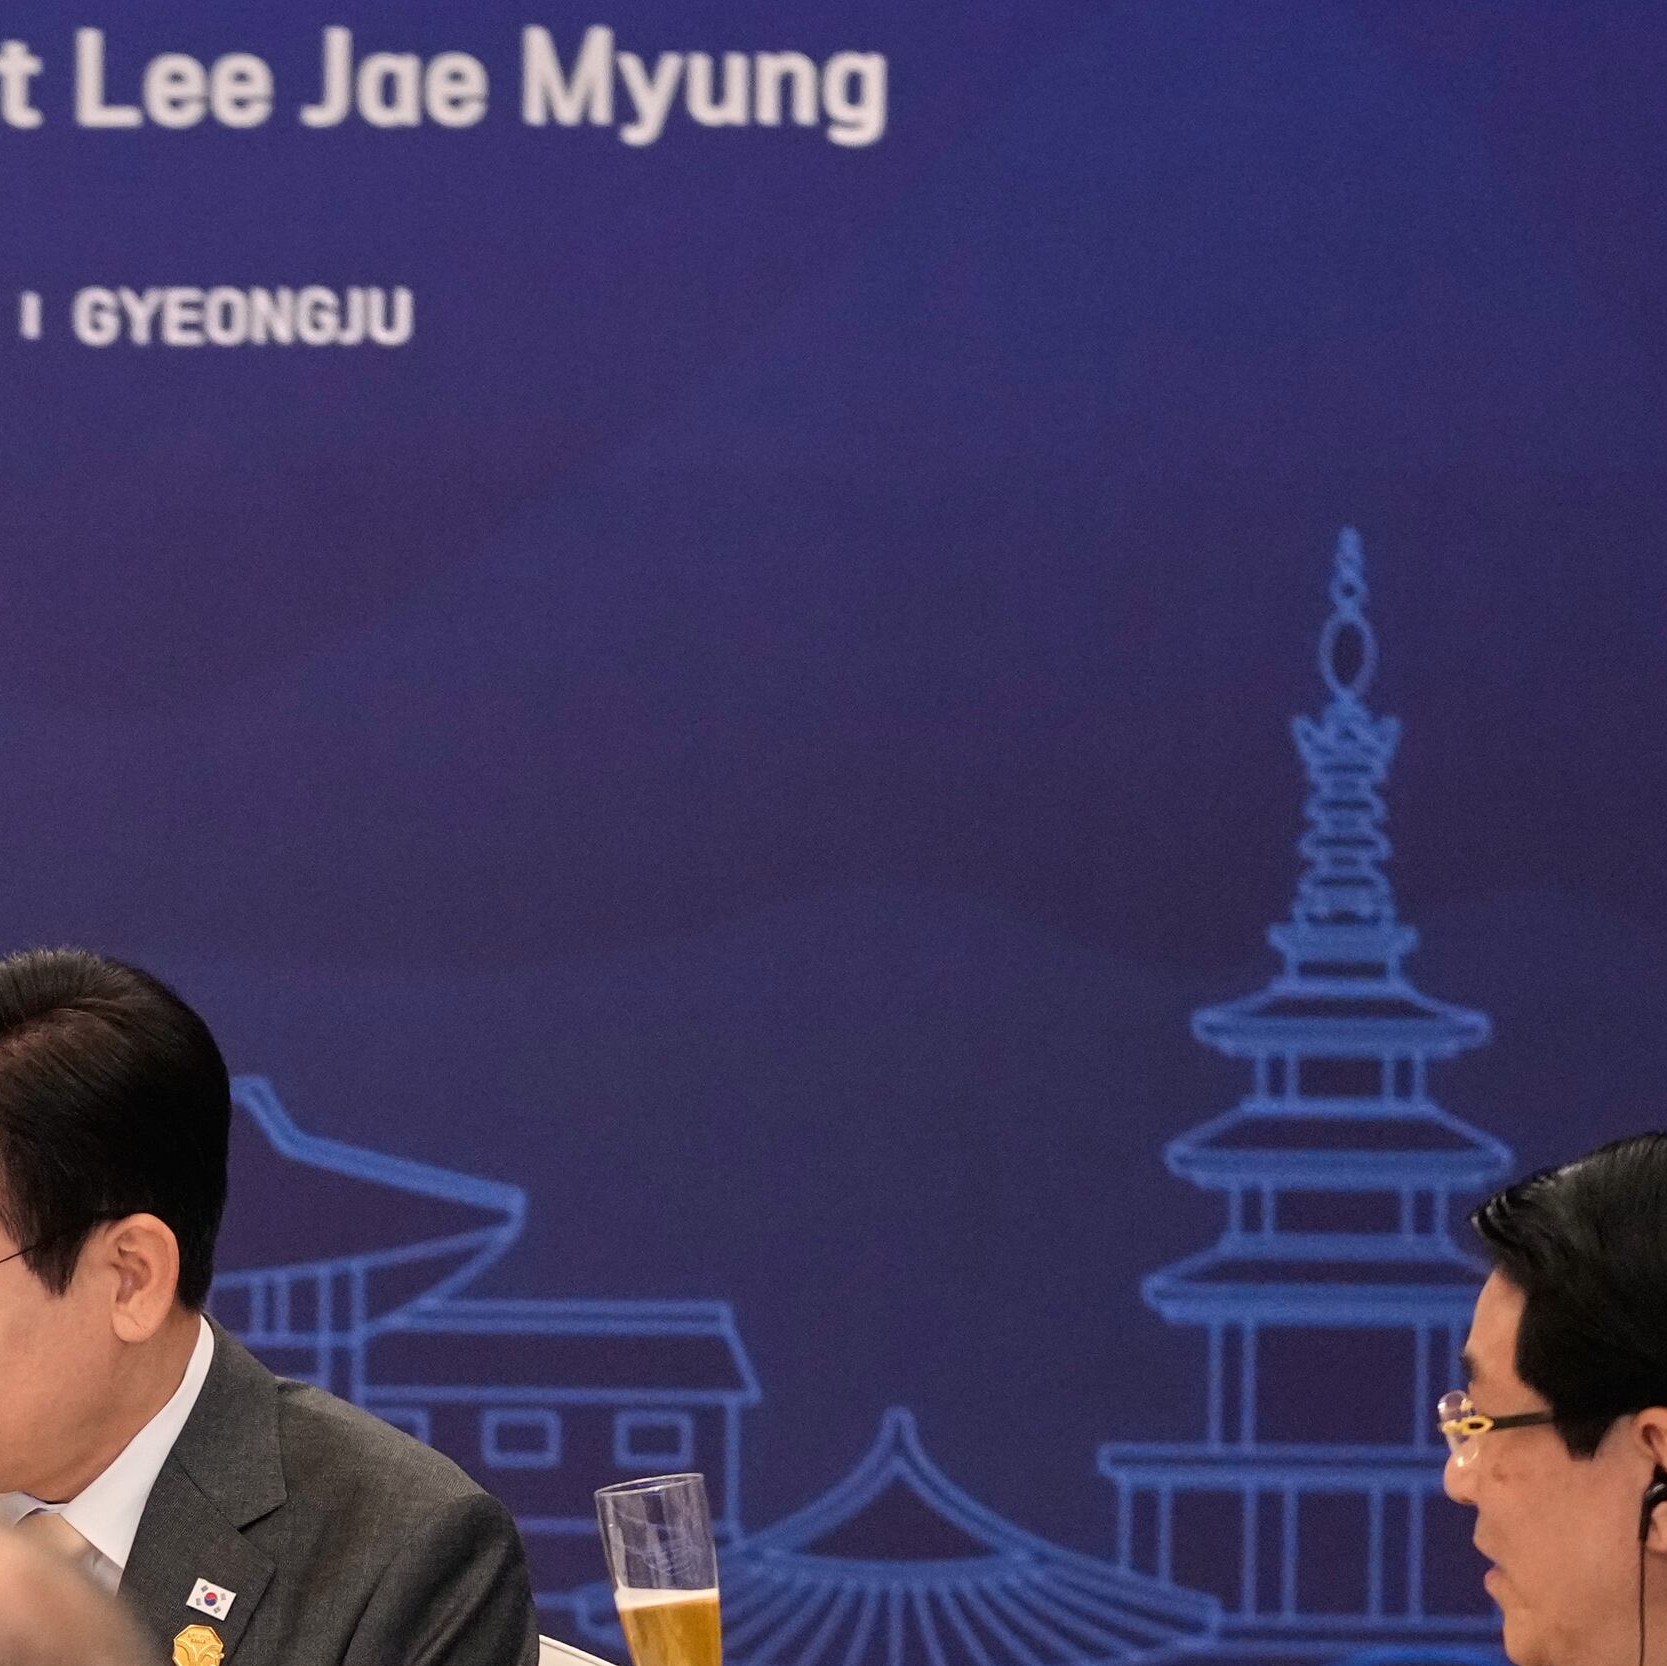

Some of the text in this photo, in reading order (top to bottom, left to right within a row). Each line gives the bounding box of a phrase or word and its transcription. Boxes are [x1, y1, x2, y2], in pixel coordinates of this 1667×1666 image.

[75, 28, 273, 128] Lee
[300, 27, 488, 128] Jae
[522, 26, 887, 147] Myung
[73, 286, 413, 347] GYEONGJU
